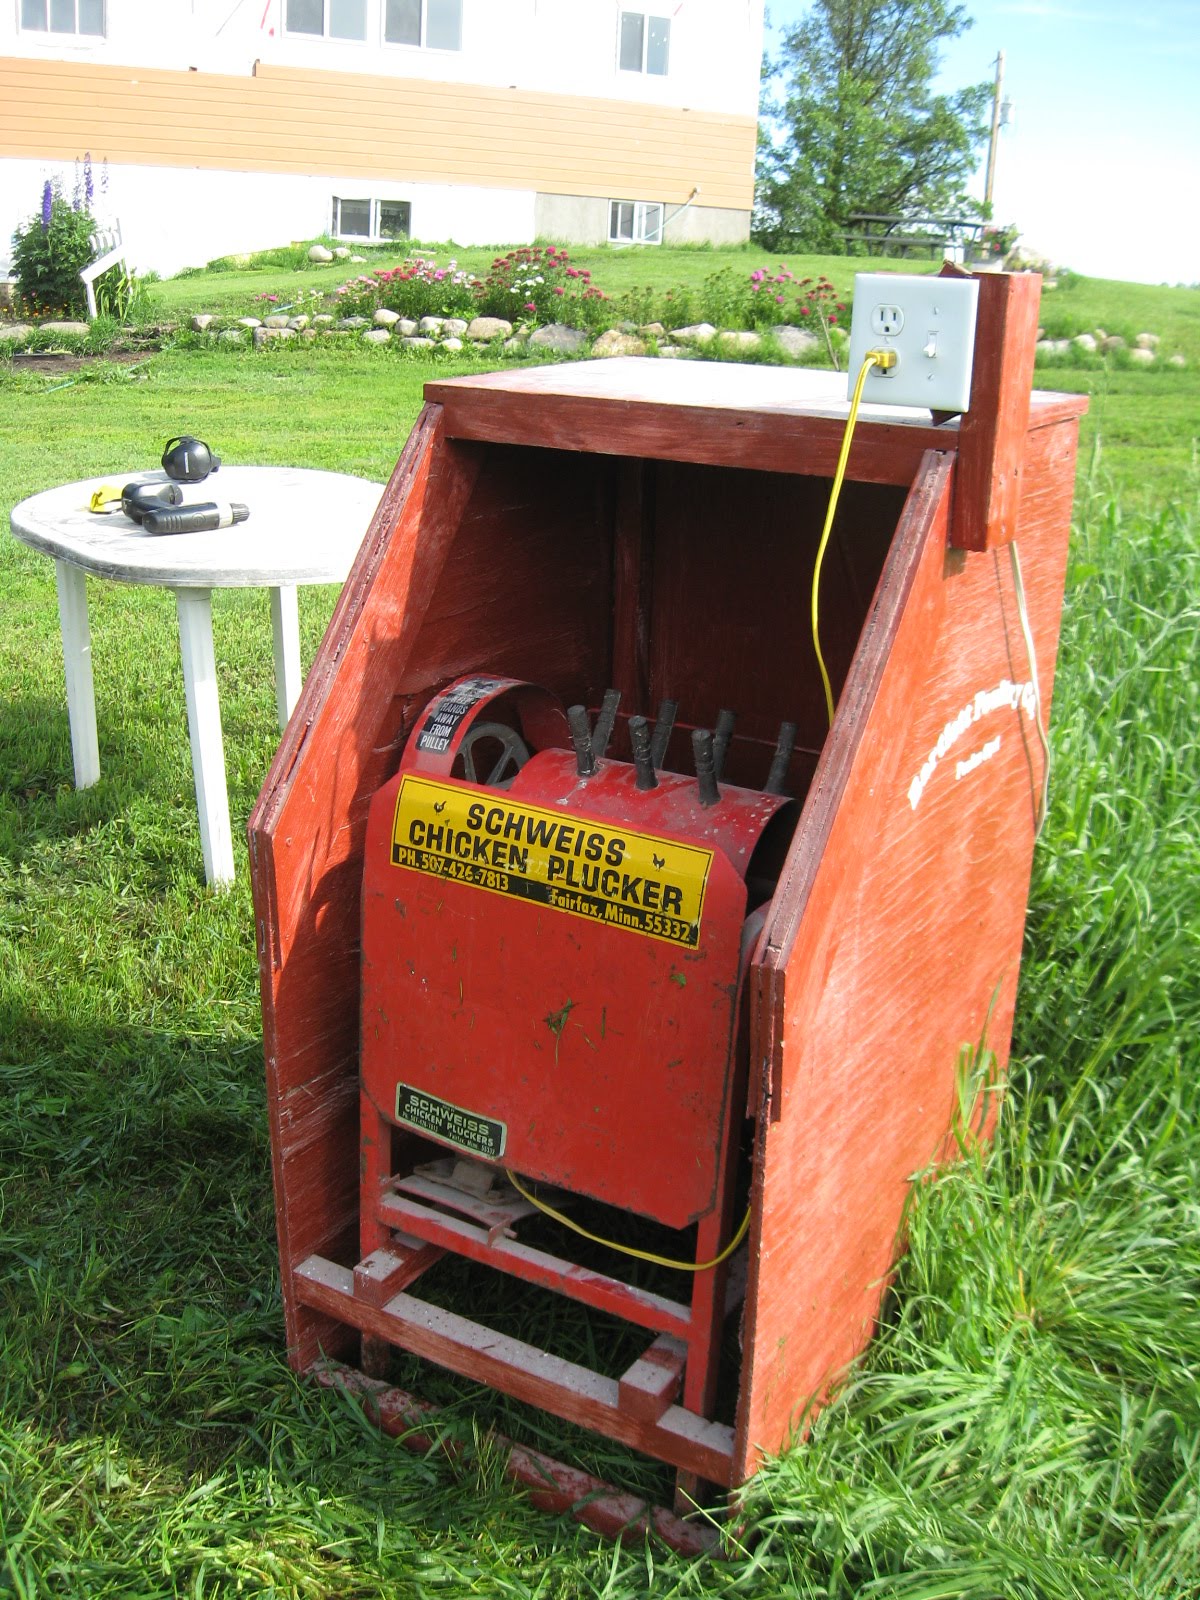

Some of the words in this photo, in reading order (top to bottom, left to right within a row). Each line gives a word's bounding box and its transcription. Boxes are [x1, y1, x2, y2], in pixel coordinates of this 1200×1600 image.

[434, 713, 460, 726] AWAY
[440, 702, 468, 715] HANDS
[420, 735, 450, 751] PULLEY
[429, 723, 452, 738] FROM
[466, 803, 626, 867] SCHWEISS
[408, 819, 529, 874] CHICKEN
[547, 854, 683, 915] PLUCKER
[421, 853, 509, 891] 507-426-7813
[550, 887, 603, 918] Fairfax,
[604, 903, 644, 929] Minn.
[645, 914, 691, 941] 55332
[404, 1103, 443, 1127] CHICKEN
[446, 1122, 494, 1147] PLUCKERS
[409, 1094, 490, 1136] SCHWEISS
